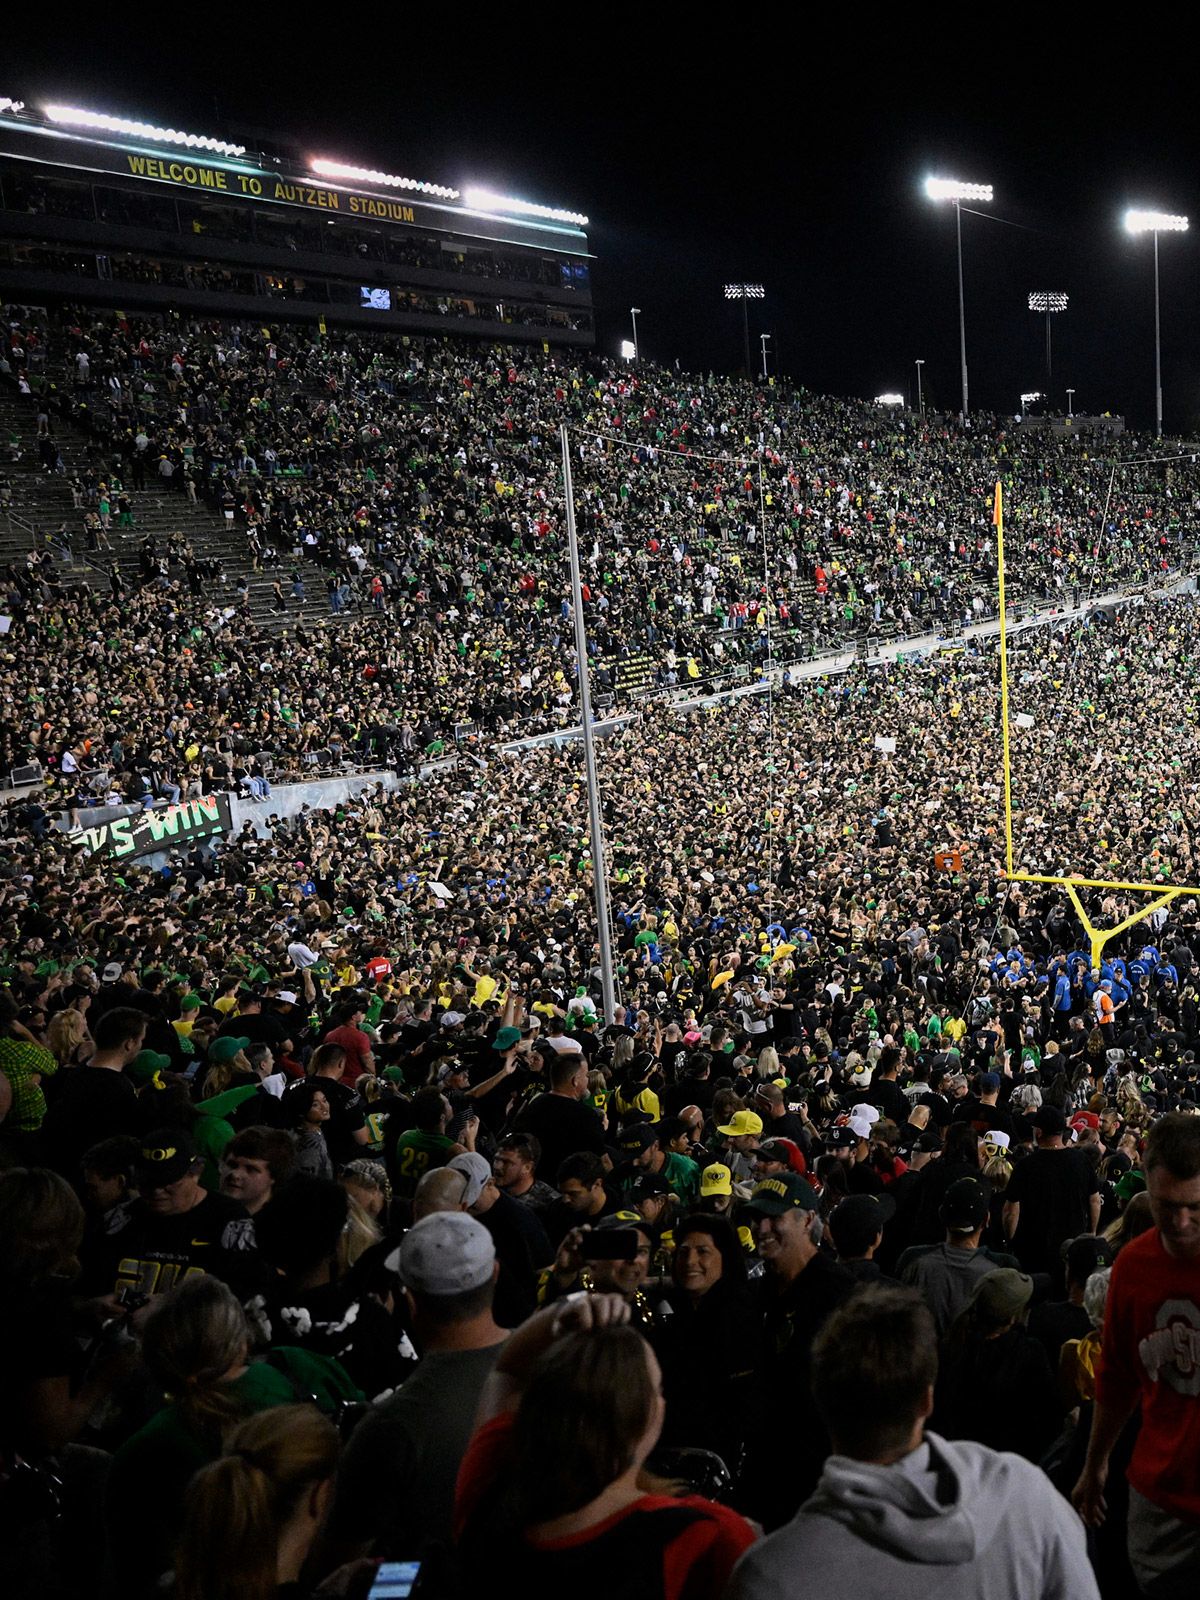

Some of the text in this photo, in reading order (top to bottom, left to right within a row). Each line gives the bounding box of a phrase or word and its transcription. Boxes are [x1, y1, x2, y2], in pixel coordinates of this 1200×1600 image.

[127, 155, 415, 223] WELCOME TO AUTZEN STADIUM
